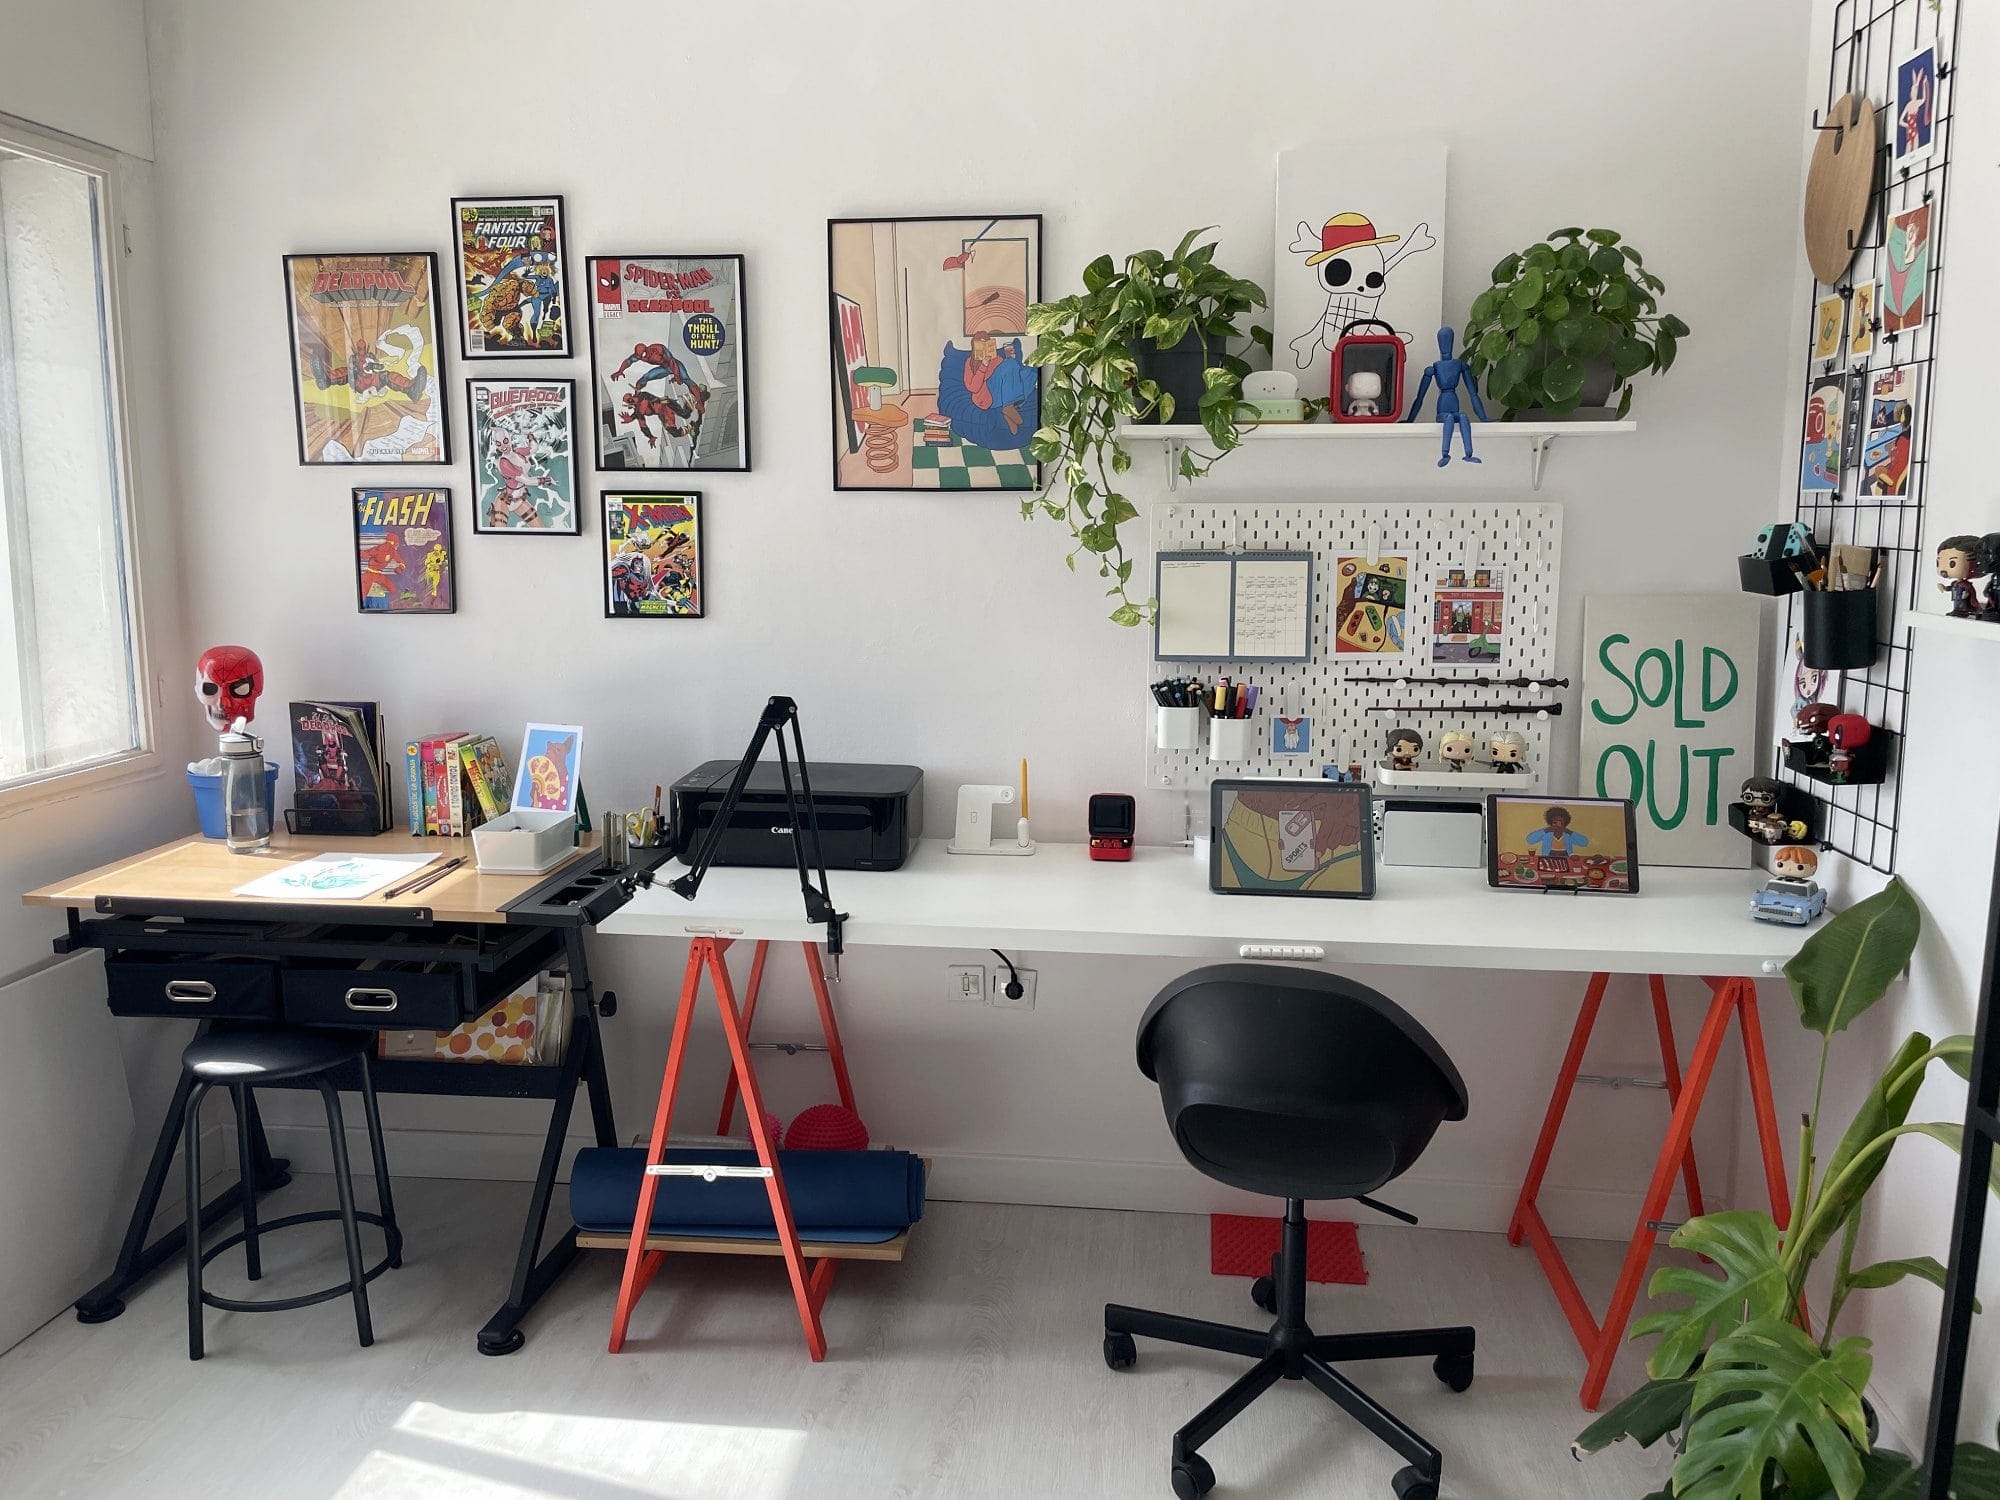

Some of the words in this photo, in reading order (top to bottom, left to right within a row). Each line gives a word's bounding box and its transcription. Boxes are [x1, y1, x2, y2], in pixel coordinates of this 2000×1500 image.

[475, 221, 545, 235] FANTASTIC
[487, 235, 527, 248] FOUR
[311, 271, 415, 297] DEADPOOL
[624, 263, 714, 291] SPIDER-MAN
[627, 299, 714, 313] DEADPOOL
[687, 324, 719, 333] THRILL
[690, 340, 719, 349] HUNT!
[490, 389, 563, 410] GWENPOOL
[362, 492, 435, 526] FLASH
[623, 504, 694, 534] X-MEN
[1591, 633, 1738, 728] SOLD
[1596, 740, 1735, 831] OUT
[1285, 841, 1309, 864] SPORTS
